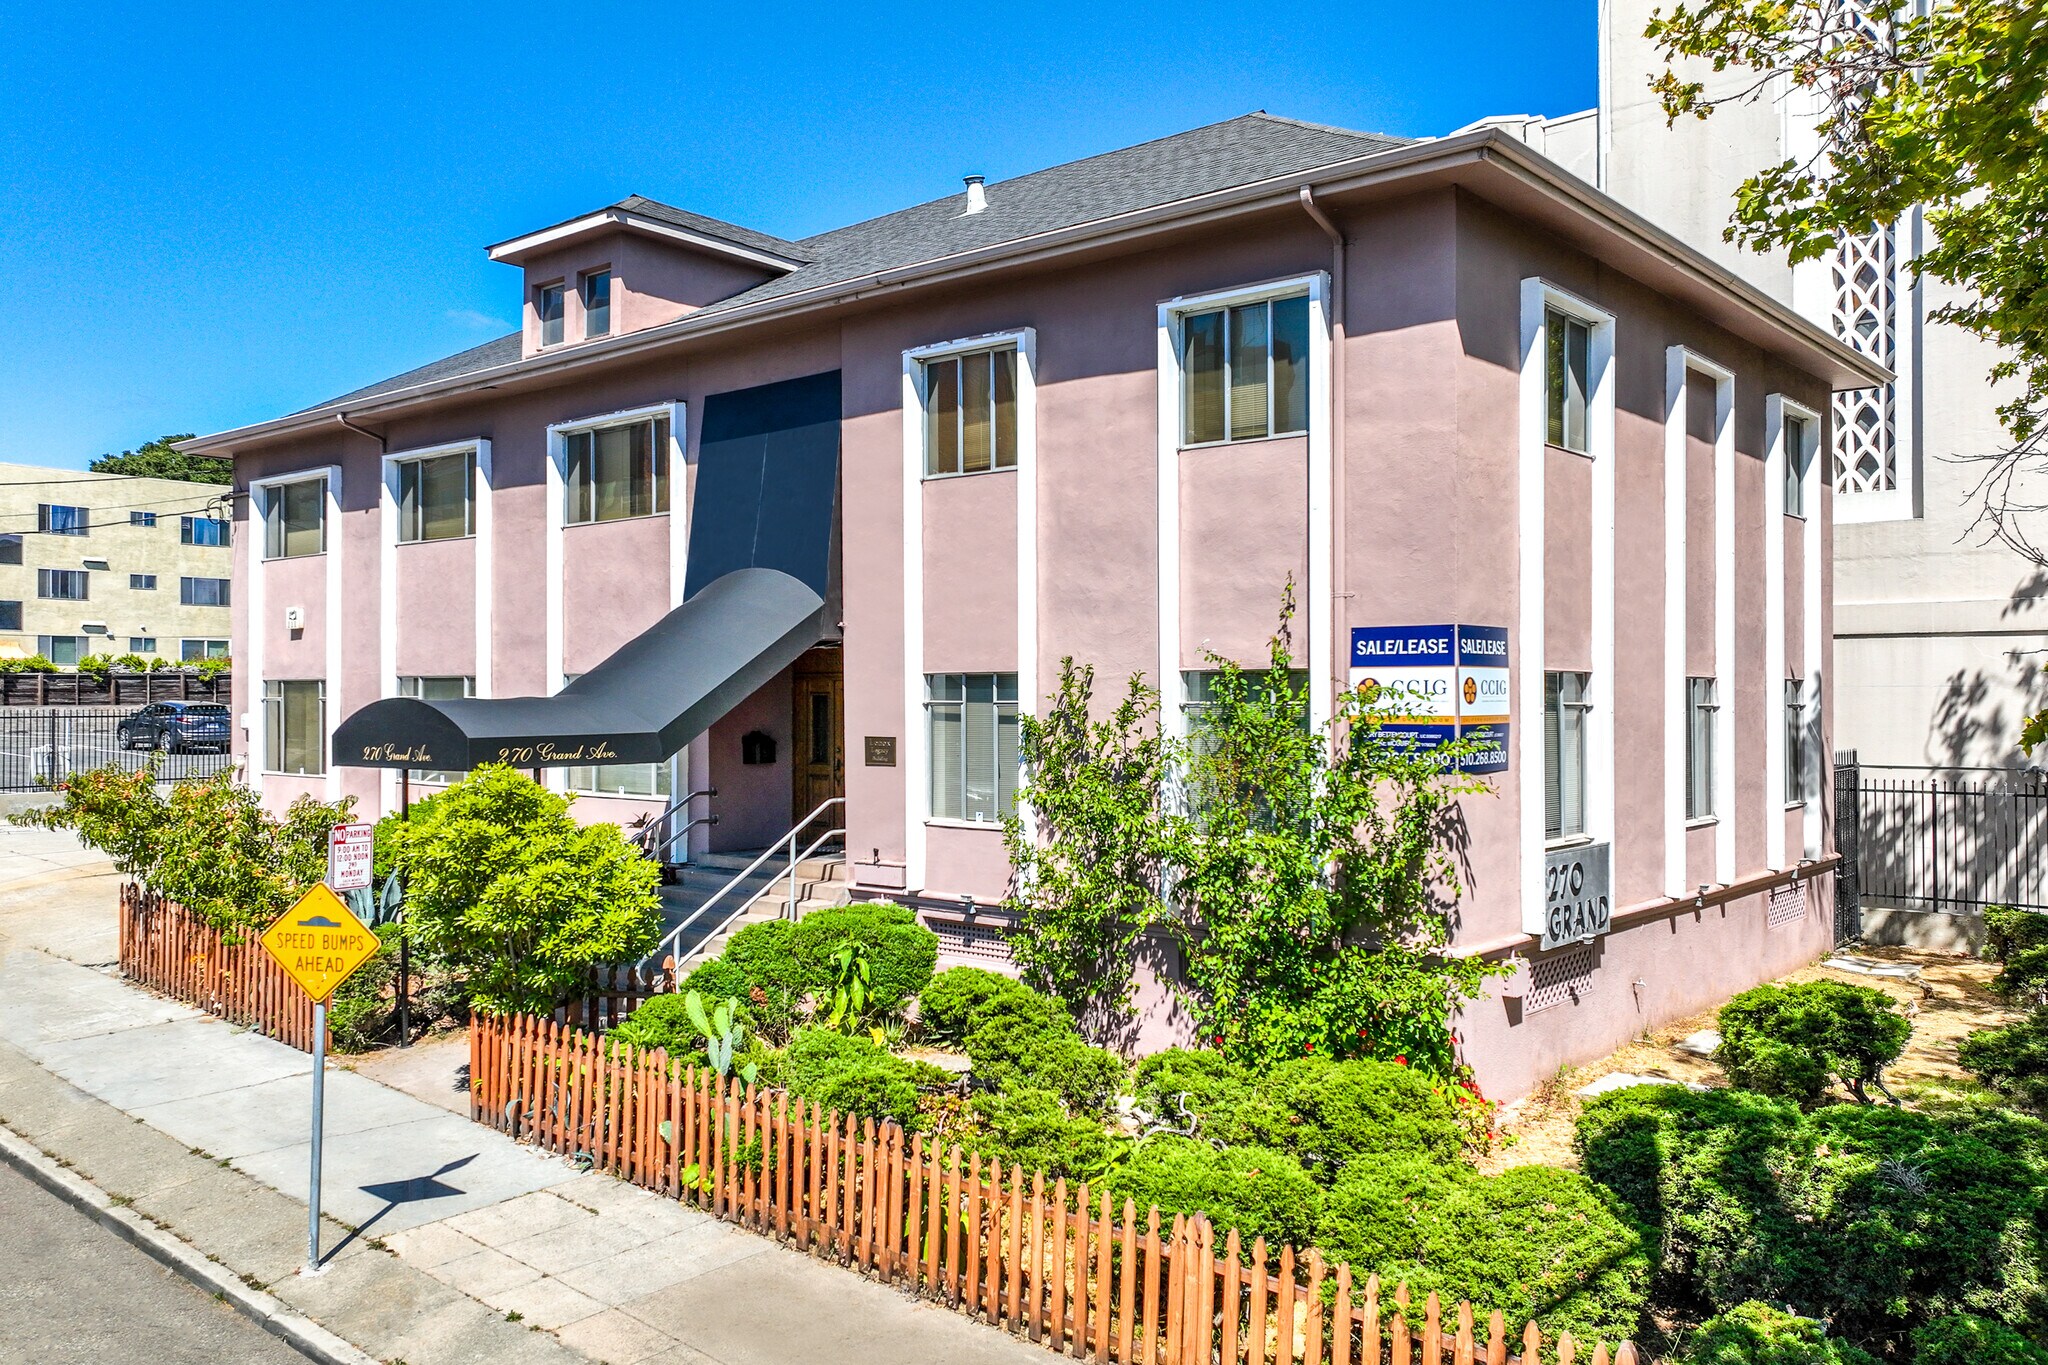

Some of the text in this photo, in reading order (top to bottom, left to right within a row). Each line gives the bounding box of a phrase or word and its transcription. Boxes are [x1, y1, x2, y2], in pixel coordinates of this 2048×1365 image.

[1356, 638, 1449, 656] SALE/LEASE
[1461, 638, 1507, 656] SALE/LEASE
[1391, 679, 1448, 696] CCIG
[1480, 679, 1507, 695] CCIG
[362, 743, 433, 762] 270 Grand Ave.
[498, 741, 618, 763] 270 Grand Ave.
[1460, 751, 1507, 766] 510.268.8500
[335, 829, 371, 842] NO PARKING
[353, 852, 369, 861] NOON
[340, 869, 364, 878] MONDAY
[1547, 862, 1584, 902] 270
[1548, 895, 1609, 942] GRAND
[277, 932, 364, 951] SPEED BUMPS
[295, 956, 344, 973] AHEAD
